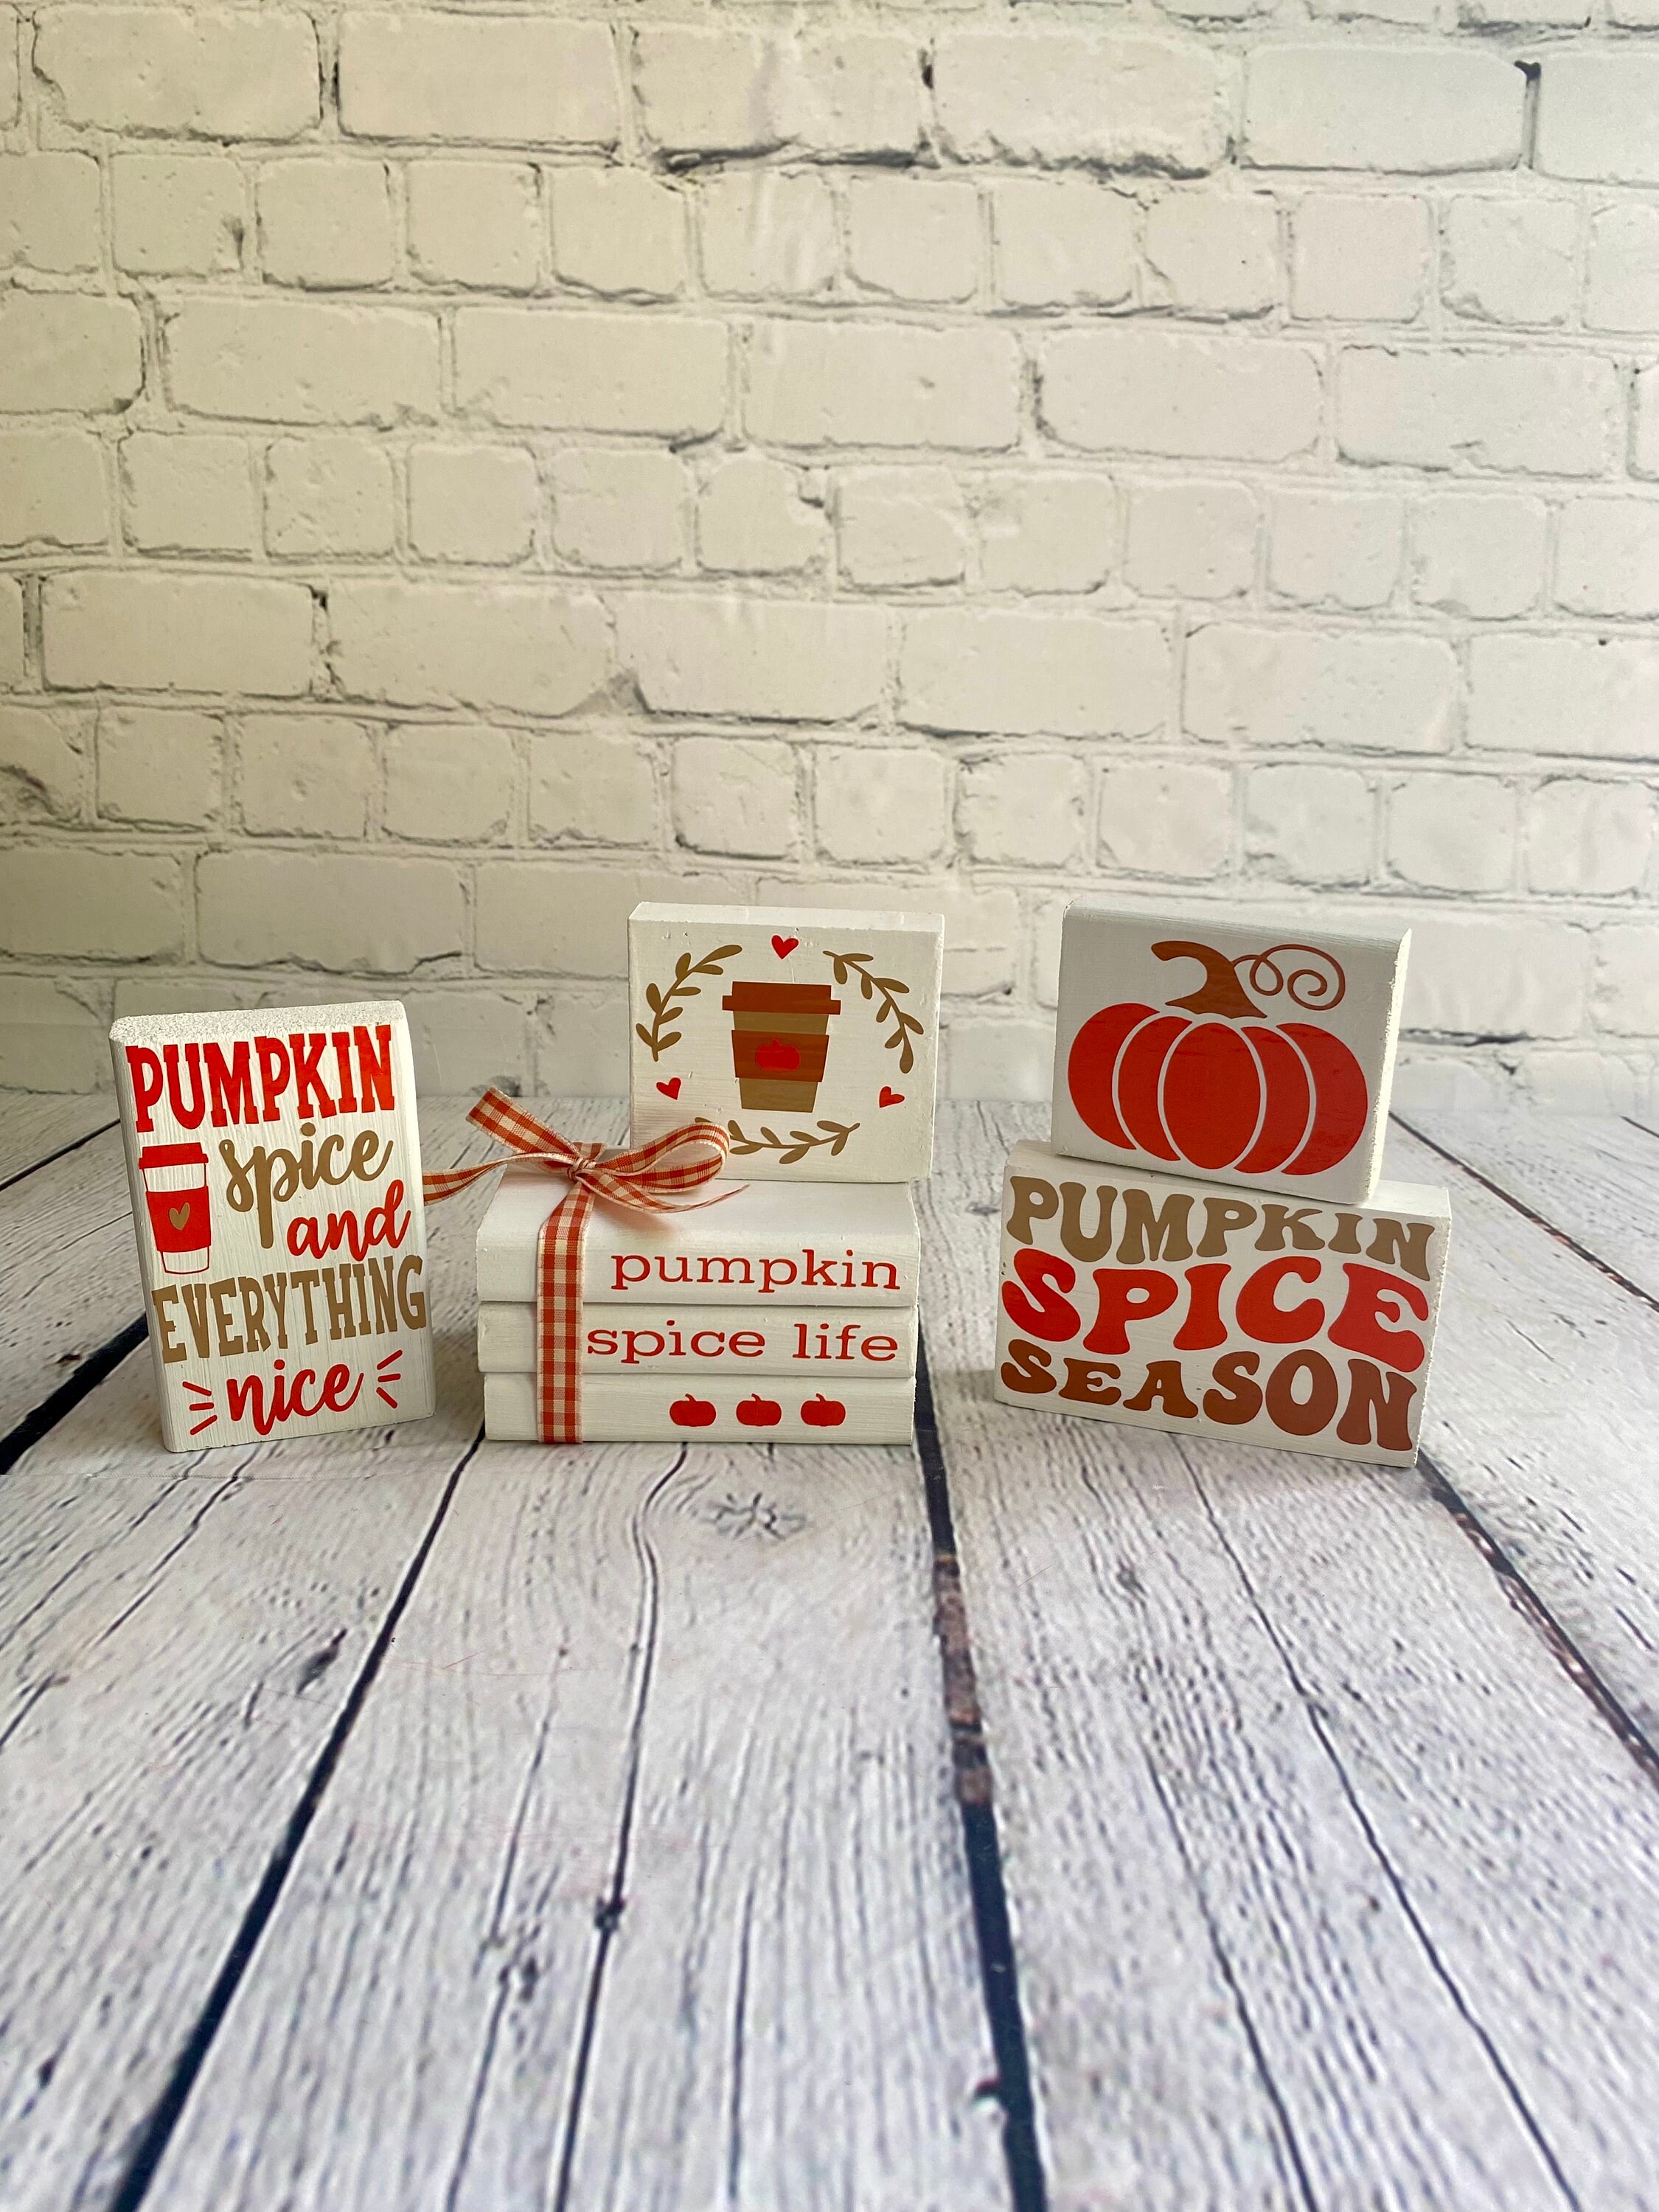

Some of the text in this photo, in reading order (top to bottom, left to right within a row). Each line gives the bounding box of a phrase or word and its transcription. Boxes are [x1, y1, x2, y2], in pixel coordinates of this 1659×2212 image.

[125, 1024, 394, 1133] PUMPKIN
[219, 1122, 393, 1248] spice
[287, 1180, 412, 1262] and
[1006, 1176, 1435, 1281] PUMPKIN
[152, 1255, 427, 1364] EVERYTHING
[611, 1249, 900, 1293] pumpkin
[1002, 1248, 1429, 1372] SPICE
[587, 1320, 898, 1363] spice life
[1001, 1338, 1416, 1450] SEASON
[227, 1359, 364, 1436] nice
